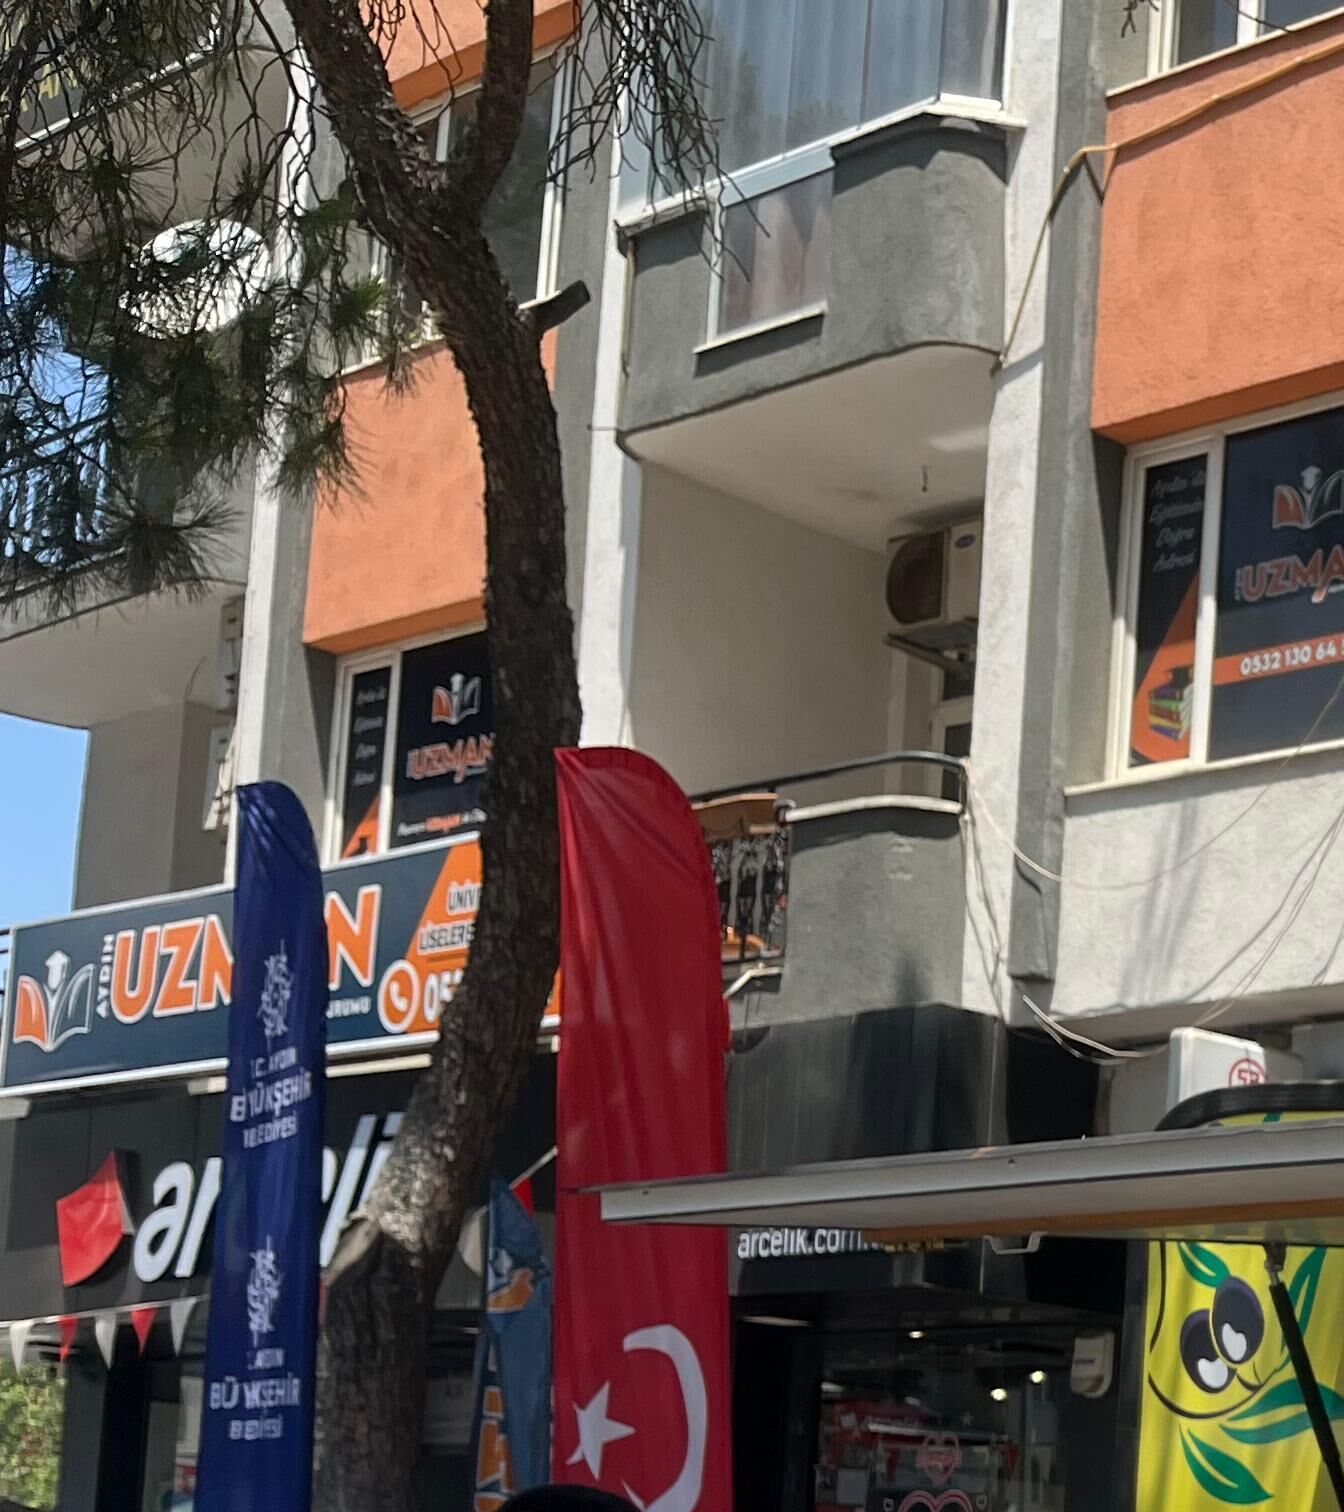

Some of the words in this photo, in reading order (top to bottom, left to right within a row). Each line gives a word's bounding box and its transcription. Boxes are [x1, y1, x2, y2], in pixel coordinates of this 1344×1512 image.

[1240, 651, 1281, 676] 0532
[1285, 645, 1312, 666] 130
[1315, 640, 1336, 660] 64
[111, 883, 382, 1024] UZMN
